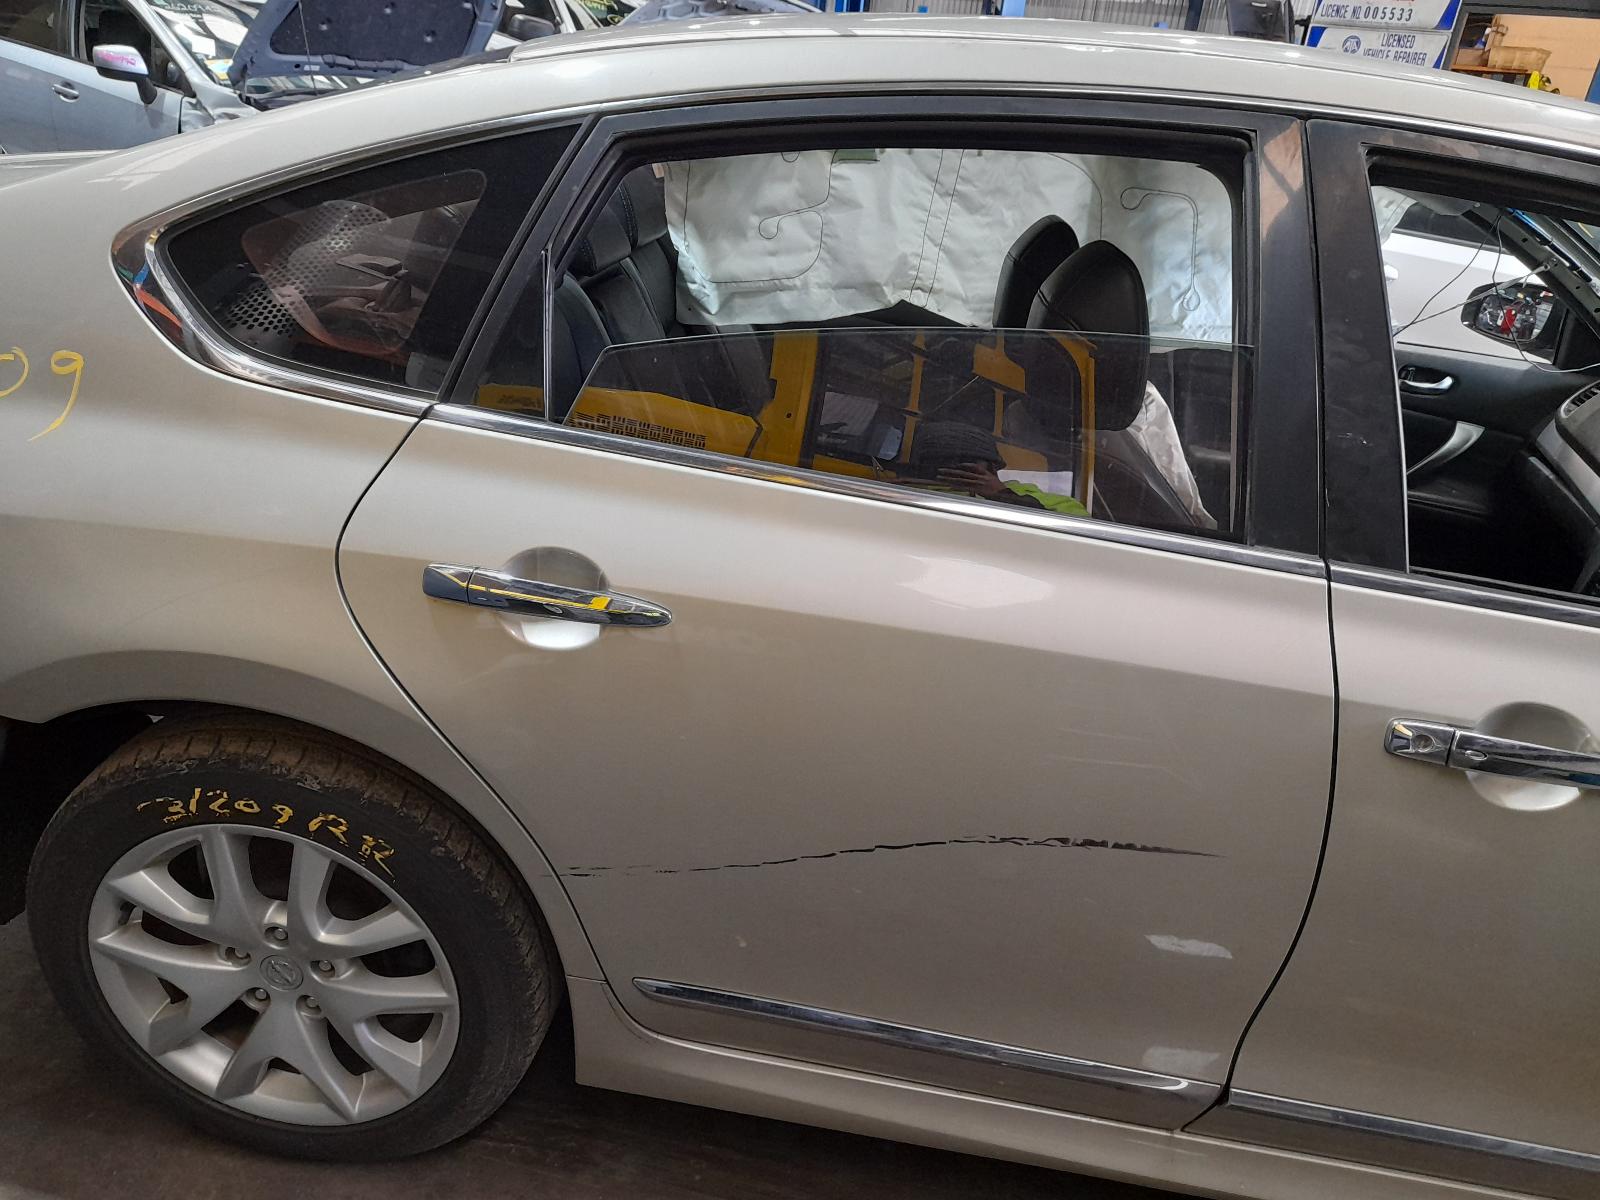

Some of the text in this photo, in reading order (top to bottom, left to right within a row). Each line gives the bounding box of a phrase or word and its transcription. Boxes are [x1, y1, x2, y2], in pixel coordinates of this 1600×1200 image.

[1321, 4, 1350, 18] LICENCE
[1364, 6, 1413, 21] 005533
[1381, 33, 1416, 49] LICENSED
[1363, 48, 1428, 66] VEHICLE REPAIRER
